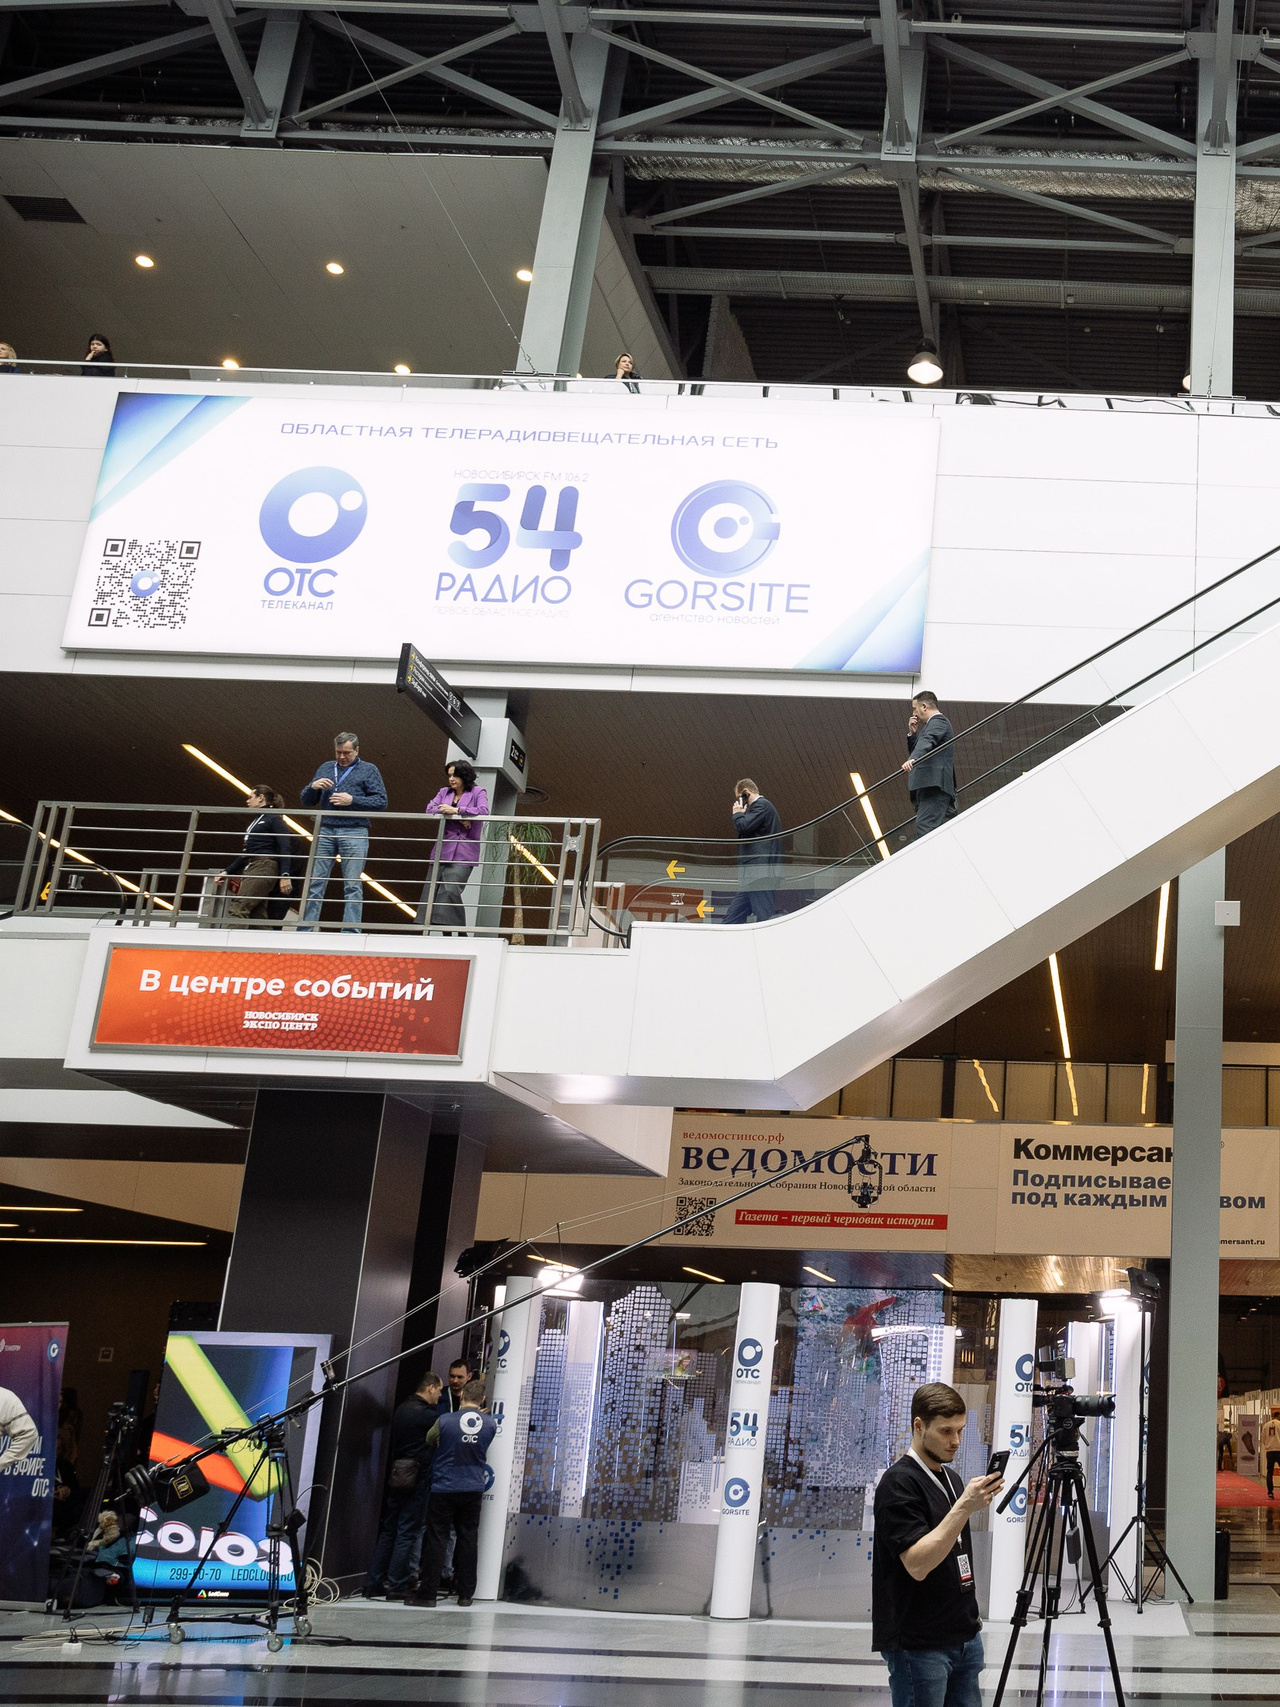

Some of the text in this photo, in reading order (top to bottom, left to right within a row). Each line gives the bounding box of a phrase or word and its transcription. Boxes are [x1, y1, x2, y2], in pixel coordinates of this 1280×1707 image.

[280, 422, 778, 449] ОБЛАСТНАЯ ТЕЛЕРАДИОВЕЩАТЕЛЬНАЯ СЕТЬ
[454, 469, 588, 483] НОВОСИБИРСК FM 106.2
[447, 482, 583, 571] 54
[435, 572, 572, 605] РАДИО
[624, 578, 811, 614] GORSITE
[261, 600, 334, 611] ТЕЛЕКАНАЛ
[716, 614, 780, 626] новостей
[139, 969, 435, 1002] В центре событий
[243, 1010, 320, 1021] НОВОСИБИРСК
[242, 1020, 318, 1031] ЭКСПО ЦЕНТР
[682, 1132, 785, 1144] ведомостинсо.рф
[1013, 1138, 1173, 1166] Коммерсан
[1012, 1169, 1172, 1190] Подписывае
[897, 1183, 936, 1193] области
[1011, 1191, 1266, 1210] под каждым вом
[738, 1211, 935, 1226] Газета первый черновик истории
[736, 1368, 760, 1379] ОТС
[729, 1412, 759, 1438] 54
[727, 1437, 757, 1447] РАДИО
[13, 1458, 46, 1476] ЭФИРЕ
[721, 1508, 750, 1516] GORSITE
[169, 1568, 222, 1581] 299-0-70
